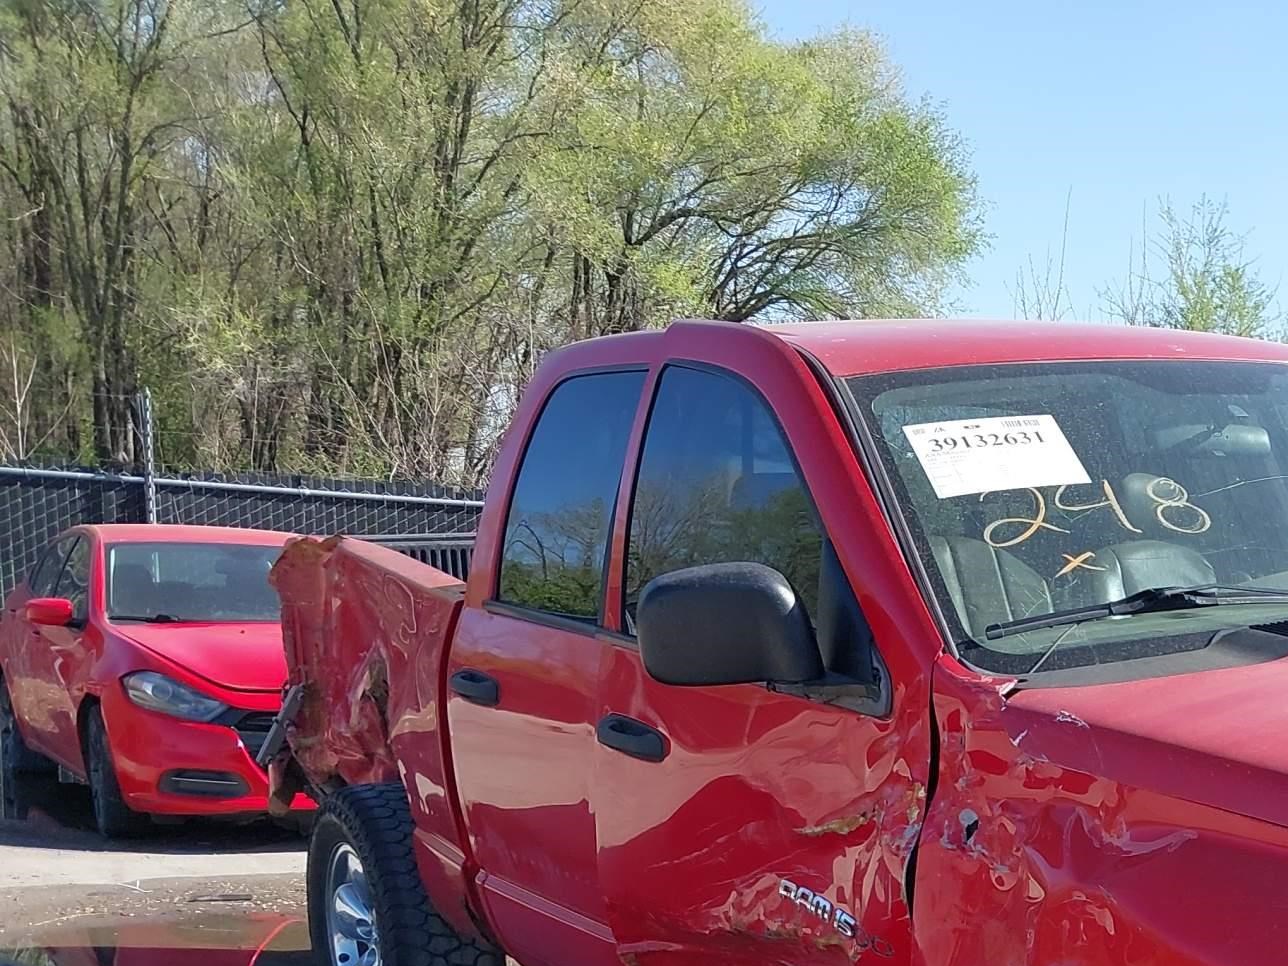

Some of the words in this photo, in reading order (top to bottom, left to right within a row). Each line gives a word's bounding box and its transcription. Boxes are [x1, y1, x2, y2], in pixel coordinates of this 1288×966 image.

[927, 430, 1047, 453] 39132631
[979, 476, 1212, 548] 248
[778, 879, 833, 923] RAM
